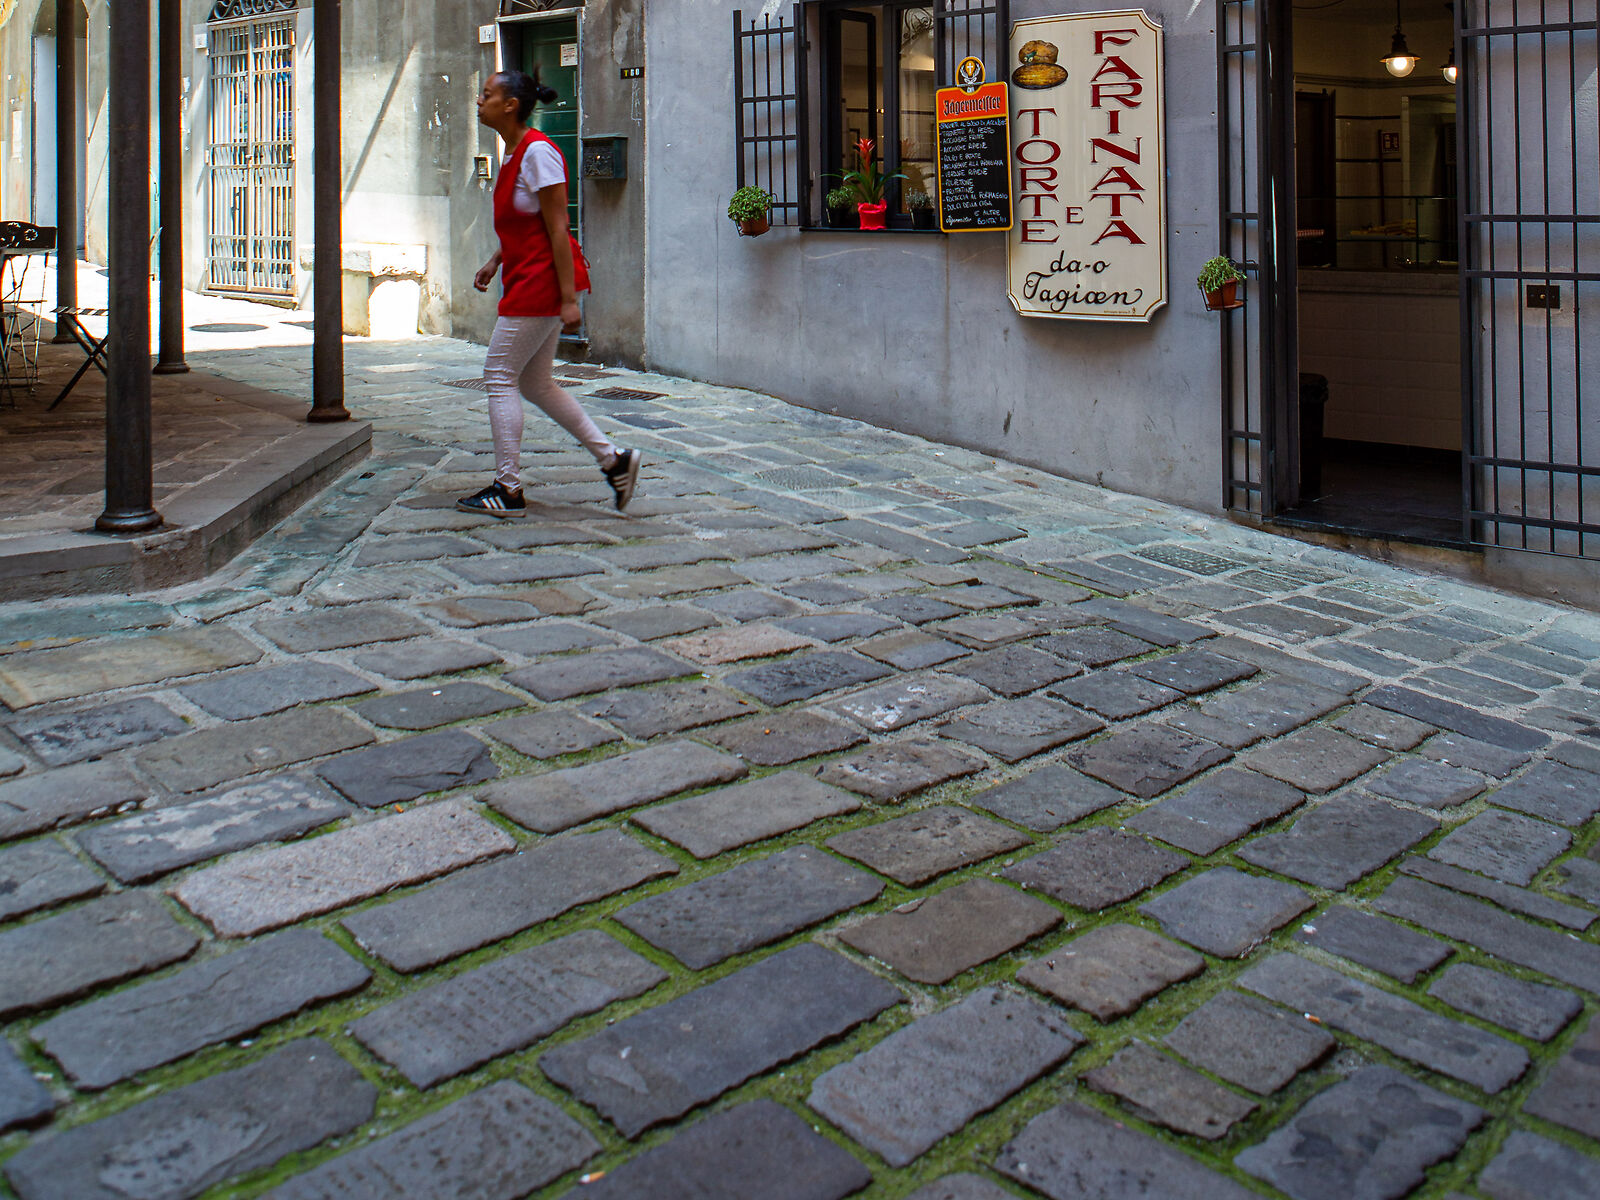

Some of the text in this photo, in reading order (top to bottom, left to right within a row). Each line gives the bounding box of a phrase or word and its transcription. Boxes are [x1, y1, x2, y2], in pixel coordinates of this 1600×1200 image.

[943, 95, 1001, 117] Jägermeister
[1016, 29, 1146, 245] TORTE E FARINATA
[1050, 250, 1112, 274] da-o
